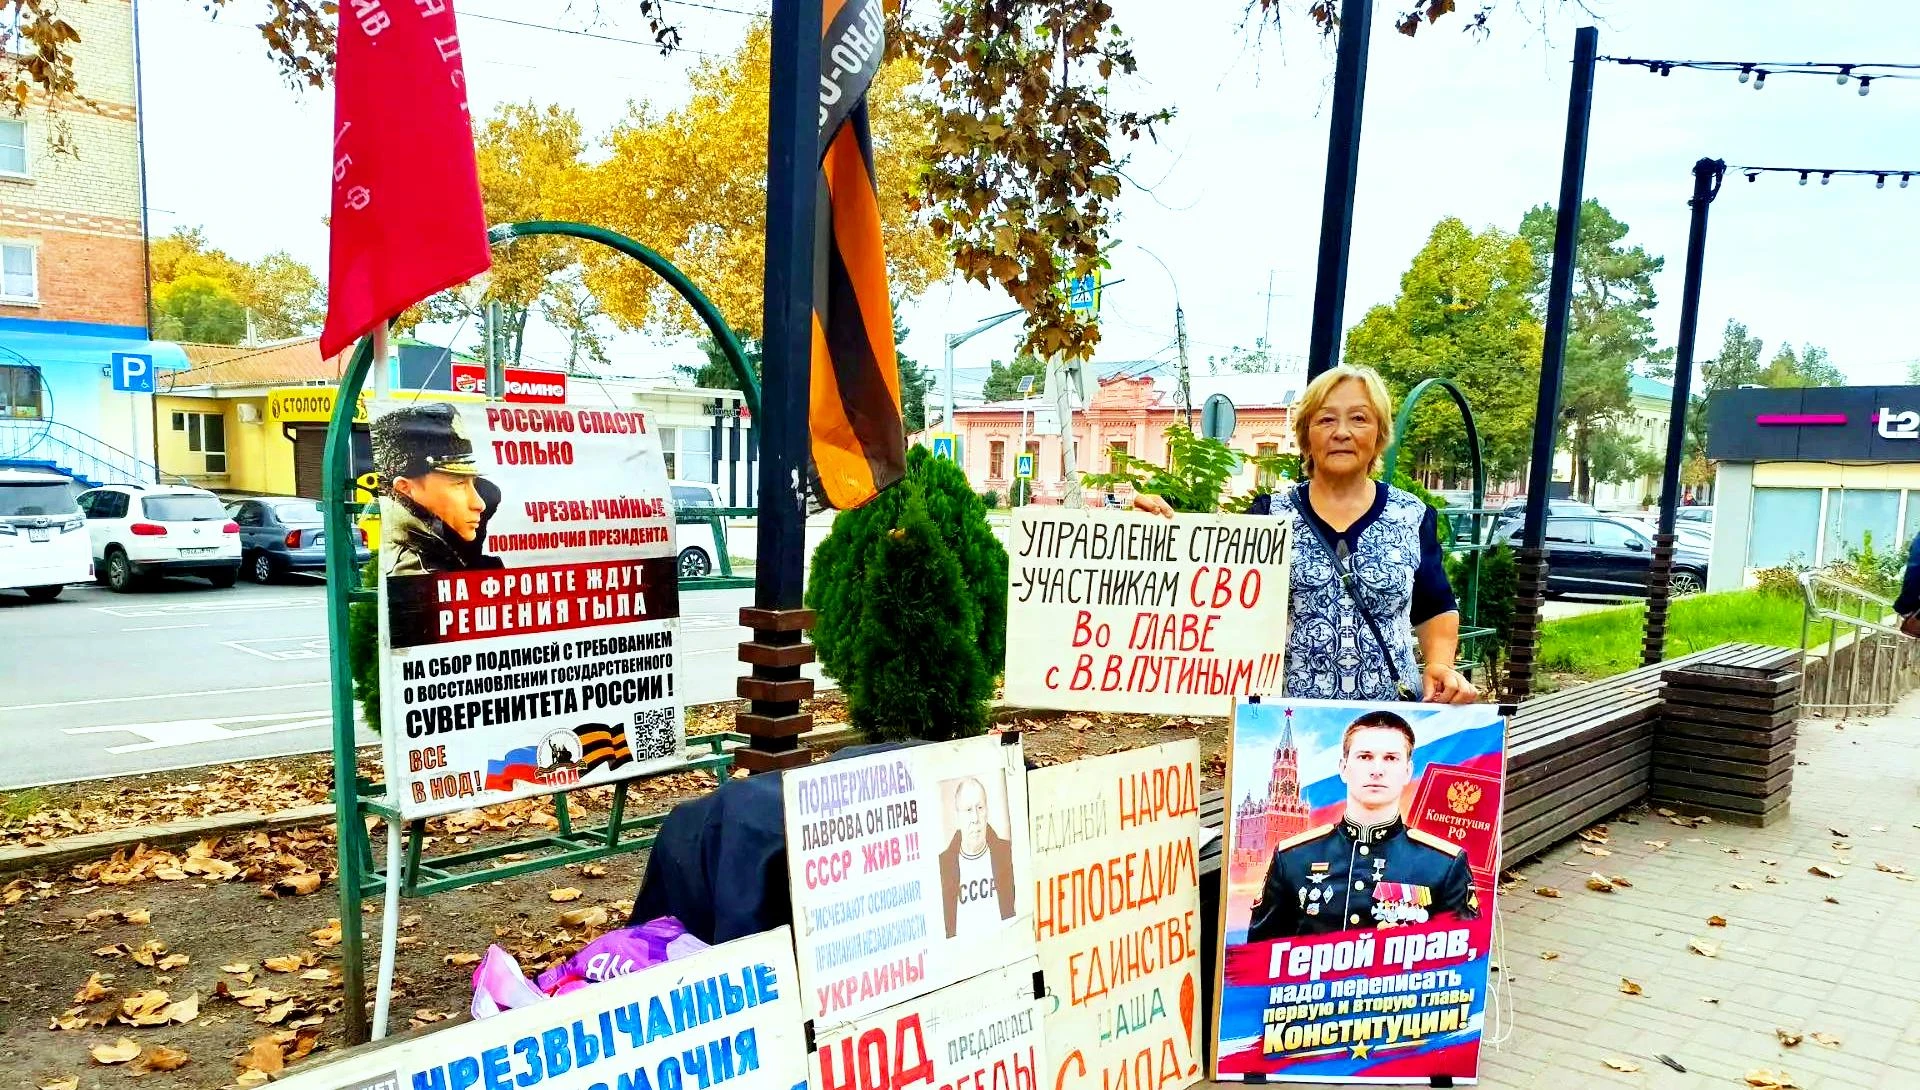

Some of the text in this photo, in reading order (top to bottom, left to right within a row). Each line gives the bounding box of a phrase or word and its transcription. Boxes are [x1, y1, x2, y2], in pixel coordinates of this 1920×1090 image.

[122, 356, 147, 388] P
[283, 396, 331, 414] СТОЛОТО
[486, 408, 647, 434] РОССИЮ СПАСУТ
[492, 440, 574, 466] ТОЛЬКО
[525, 495, 666, 523] ЧРЕЗВЫЧАЙНЫЕ
[488, 526, 669, 553] ПОЛНОМОЧИЯ ПРЕЗИДЕНТА
[1019, 520, 1288, 565] УПРАВЛЕНИЕ СТРАНОЙ
[437, 564, 644, 602] НА ФРОНТЕ ЖДУТ
[1012, 566, 1262, 609] -УЧАСТНИКАМ СВО
[439, 592, 648, 636] РЕШЕНИЯ ТЫЛА
[1128, 612, 1221, 652] ГЛАВЕ
[403, 630, 672, 681] НА СБОР ПОДПИСЕЙ С ТРЕБОВАНИЕМ
[403, 653, 673, 705] О ВОССТАНОВЛЕНИИ ГОСУДАРСТВЕННОГО
[405, 690, 578, 739] СУВЕРЕНИТЕТА
[582, 675, 663, 709] РОССИИ
[409, 745, 448, 772] ВСЕ
[546, 768, 580, 786] НОД
[412, 770, 484, 803] В НОД!
[802, 799, 919, 851] ЛАВРОВА ОН ПРАВ
[1035, 762, 1199, 855] ЕДИНЫЙ НАРОД
[1425, 808, 1491, 831] Конституция
[1447, 826, 1467, 841] РФ
[805, 850, 852, 890] СССР
[861, 837, 902, 874] ЖИВ
[868, 879, 922, 915] ОСНОВАНИЯ
[1034, 836, 1197, 942] НЕПОБЕДИМ
[1069, 910, 1196, 1008] ЕДИНСТВЕ
[1268, 929, 1478, 980] Герой прав,
[1263, 988, 1475, 1024] первую и вторую главы
[1269, 970, 1462, 1005] надо переписать
[1097, 987, 1167, 1048] НАША
[1263, 1003, 1471, 1054] Конституции!
[819, 1012, 935, 1090] НОД
